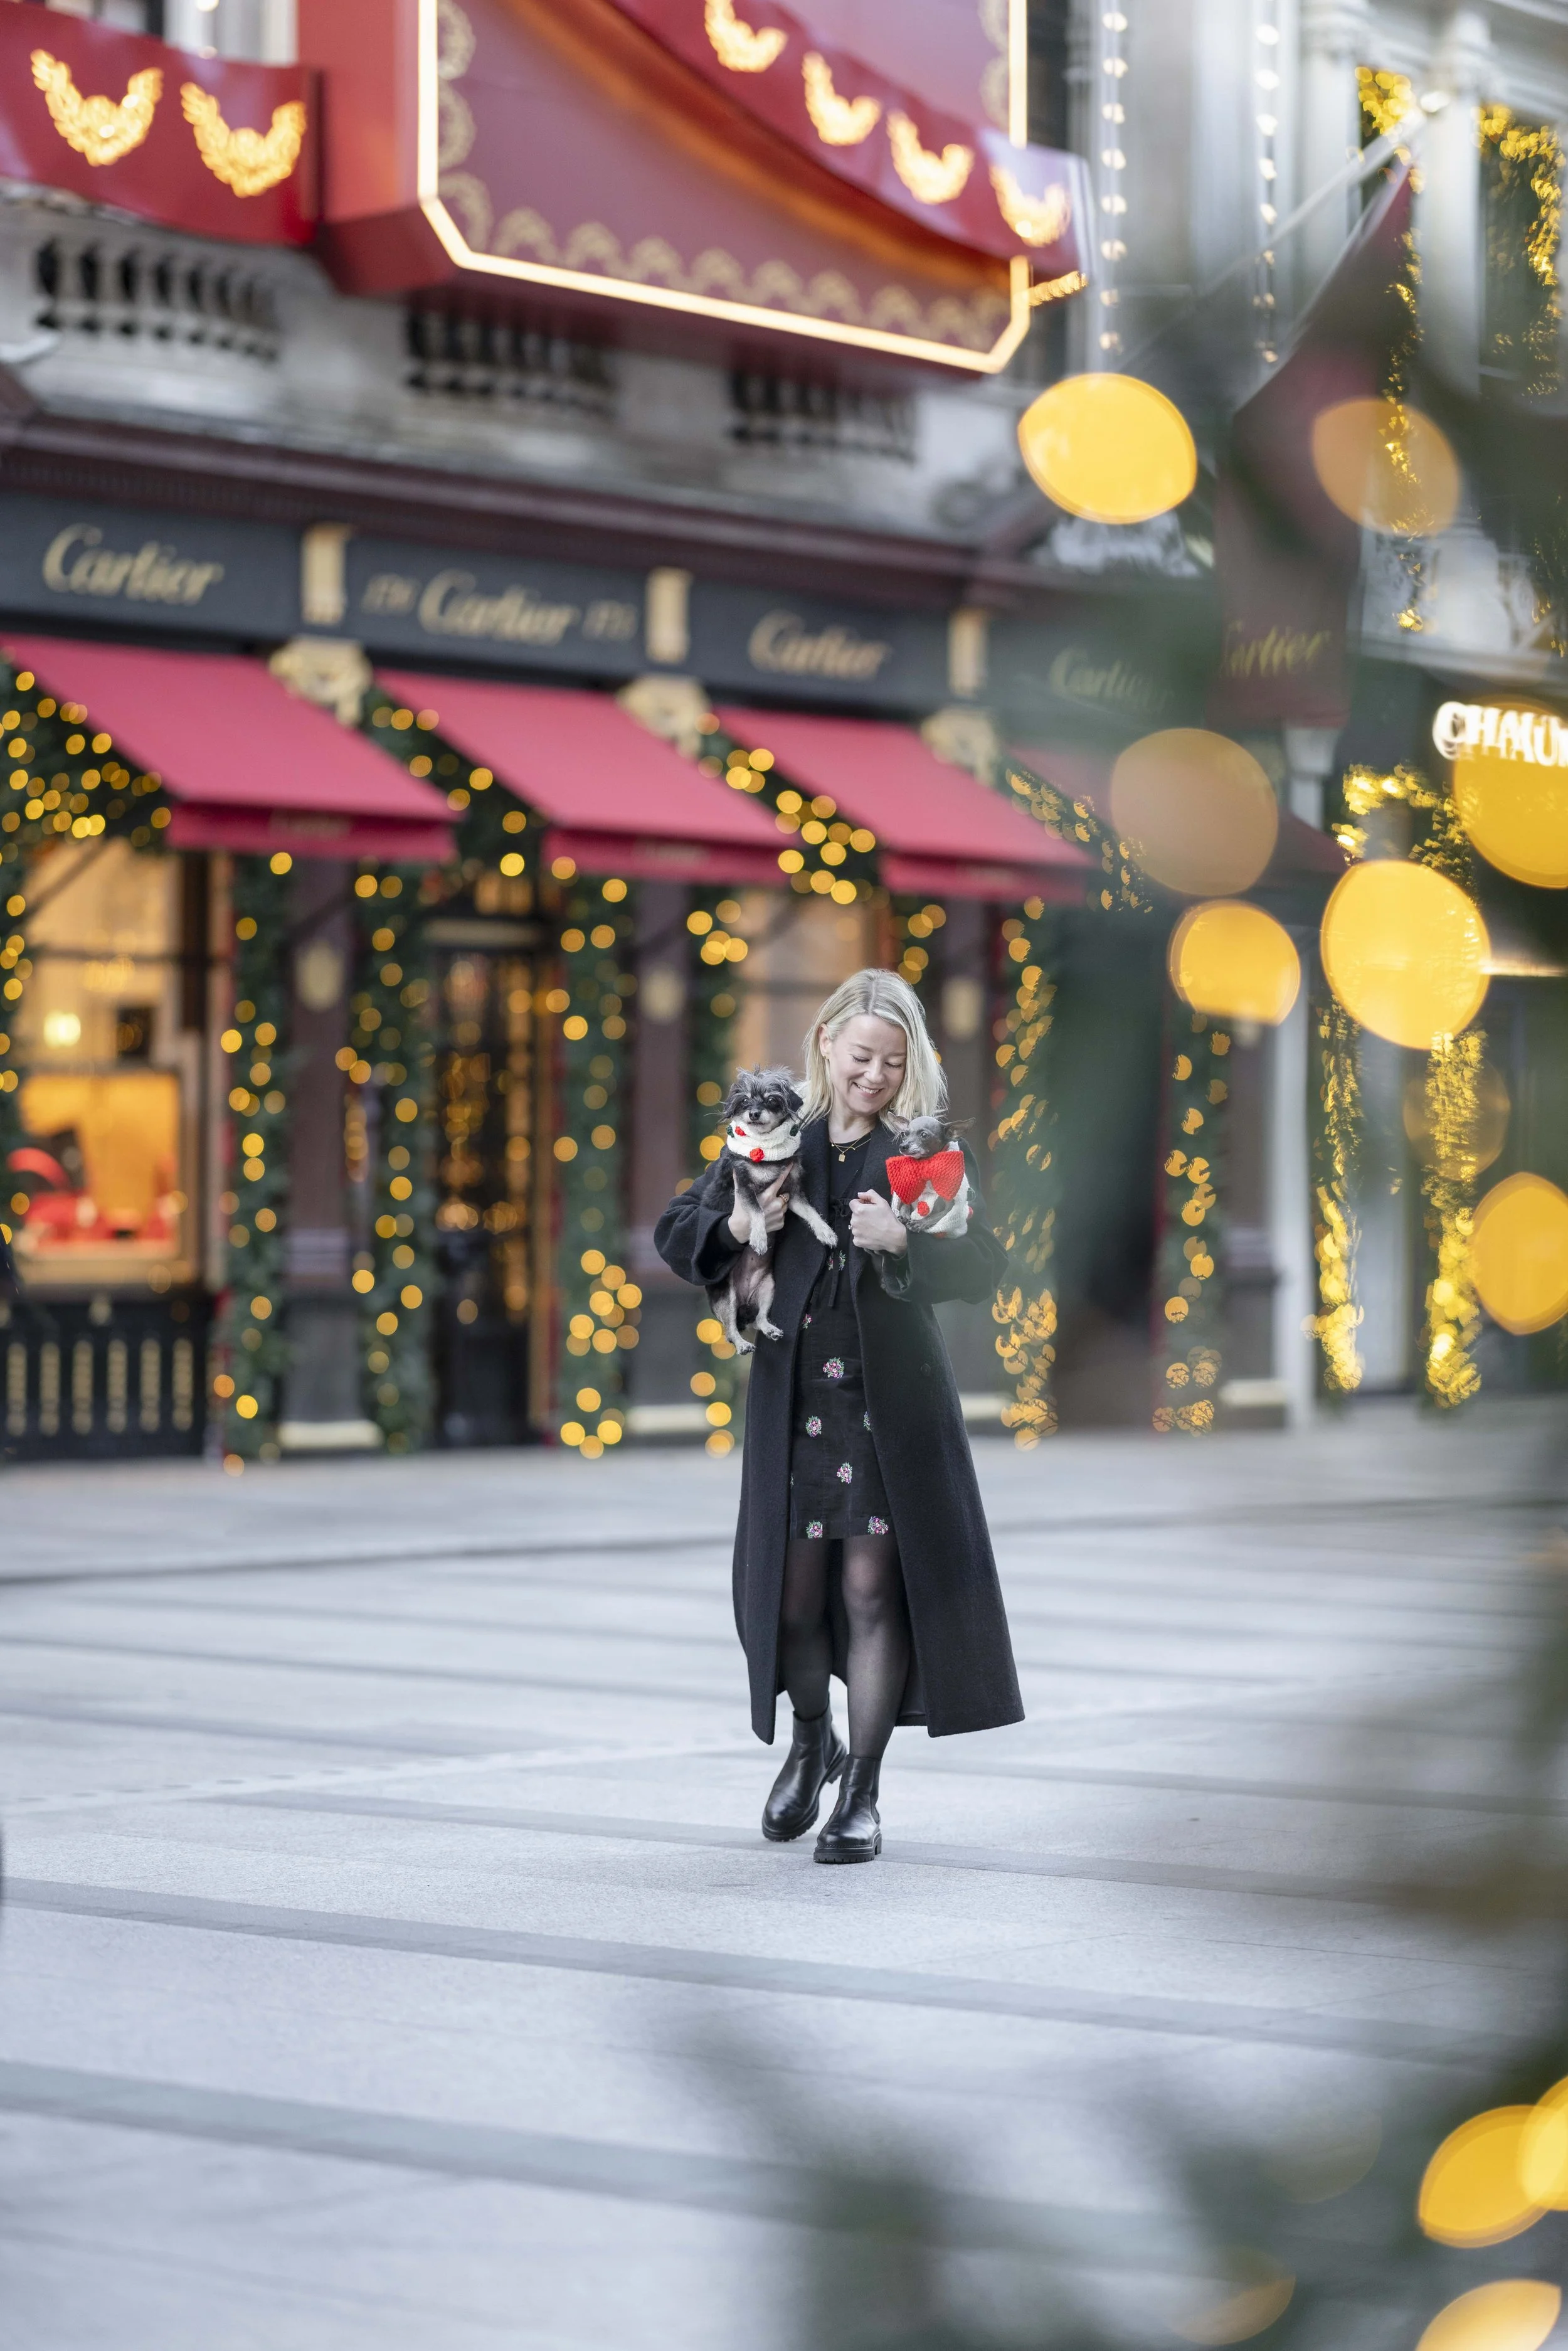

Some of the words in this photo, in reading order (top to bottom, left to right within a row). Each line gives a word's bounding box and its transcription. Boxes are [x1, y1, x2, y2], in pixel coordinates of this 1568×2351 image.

[43, 523, 224, 606] Cartier
[419, 570, 580, 645] Cartier
[1433, 701, 1568, 768] CHAU
